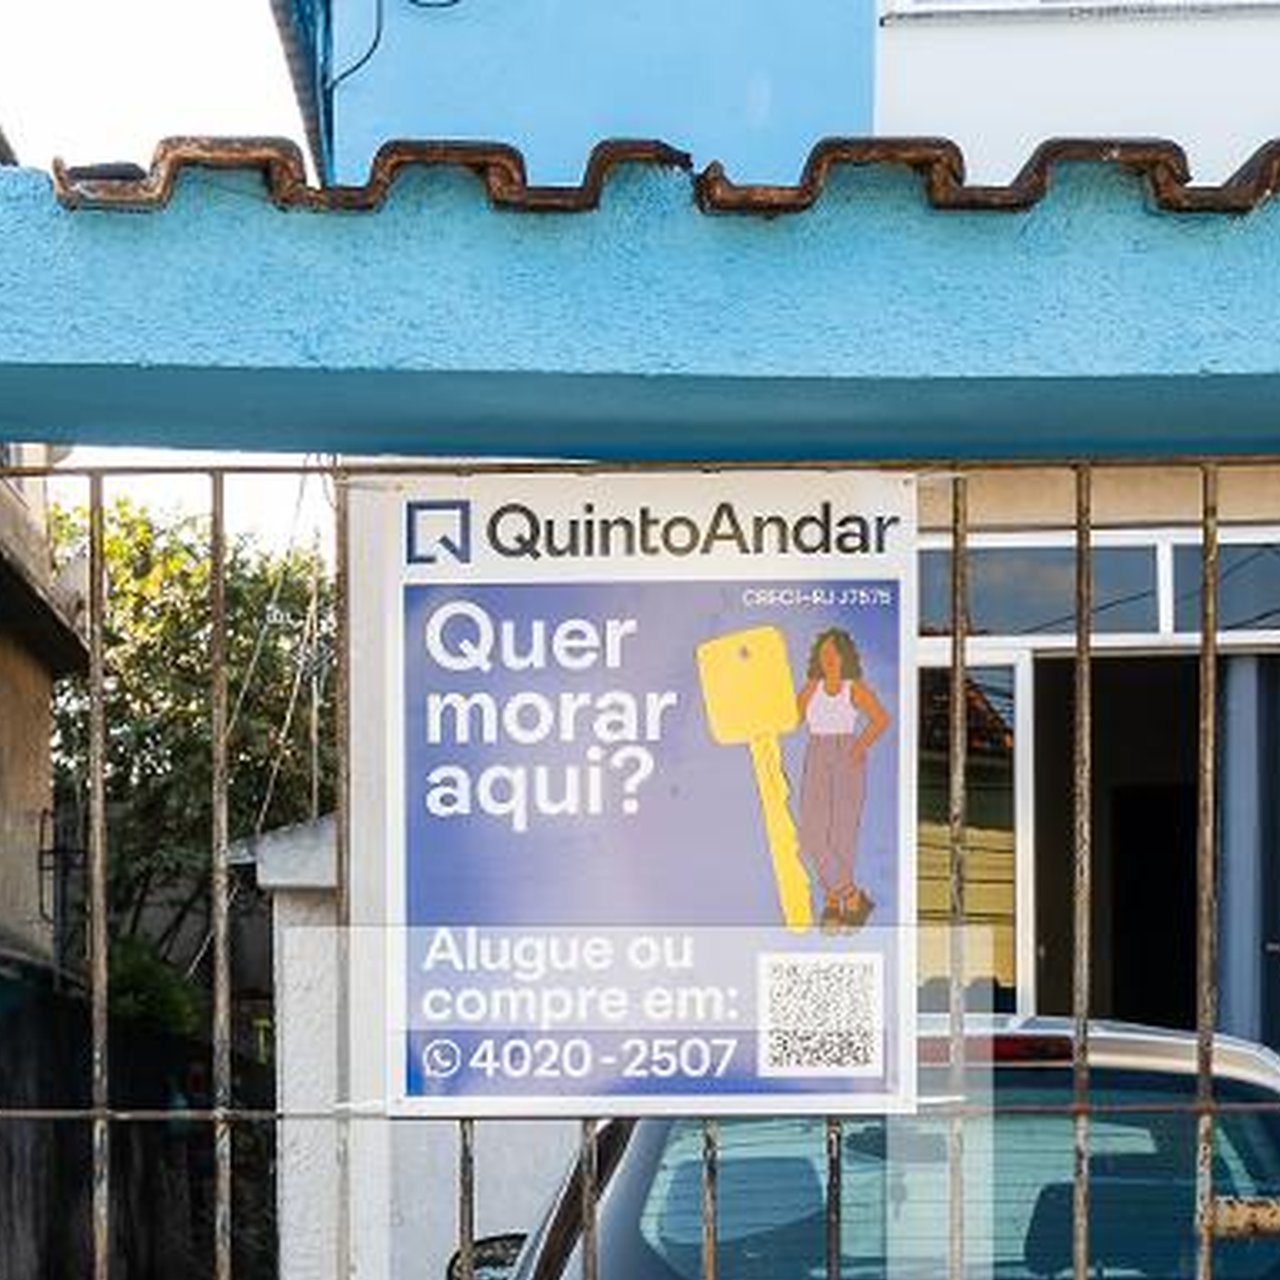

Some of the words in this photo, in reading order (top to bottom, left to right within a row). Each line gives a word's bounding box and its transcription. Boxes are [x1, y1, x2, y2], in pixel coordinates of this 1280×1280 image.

[486, 502, 899, 560] QuintoAndar
[424, 601, 637, 672] Quer
[425, 690, 678, 744] morar
[425, 746, 654, 831] aqui?
[423, 926, 614, 980] Alugue
[627, 933, 694, 970] ou
[422, 986, 628, 1031] compre
[642, 985, 740, 1020] em:
